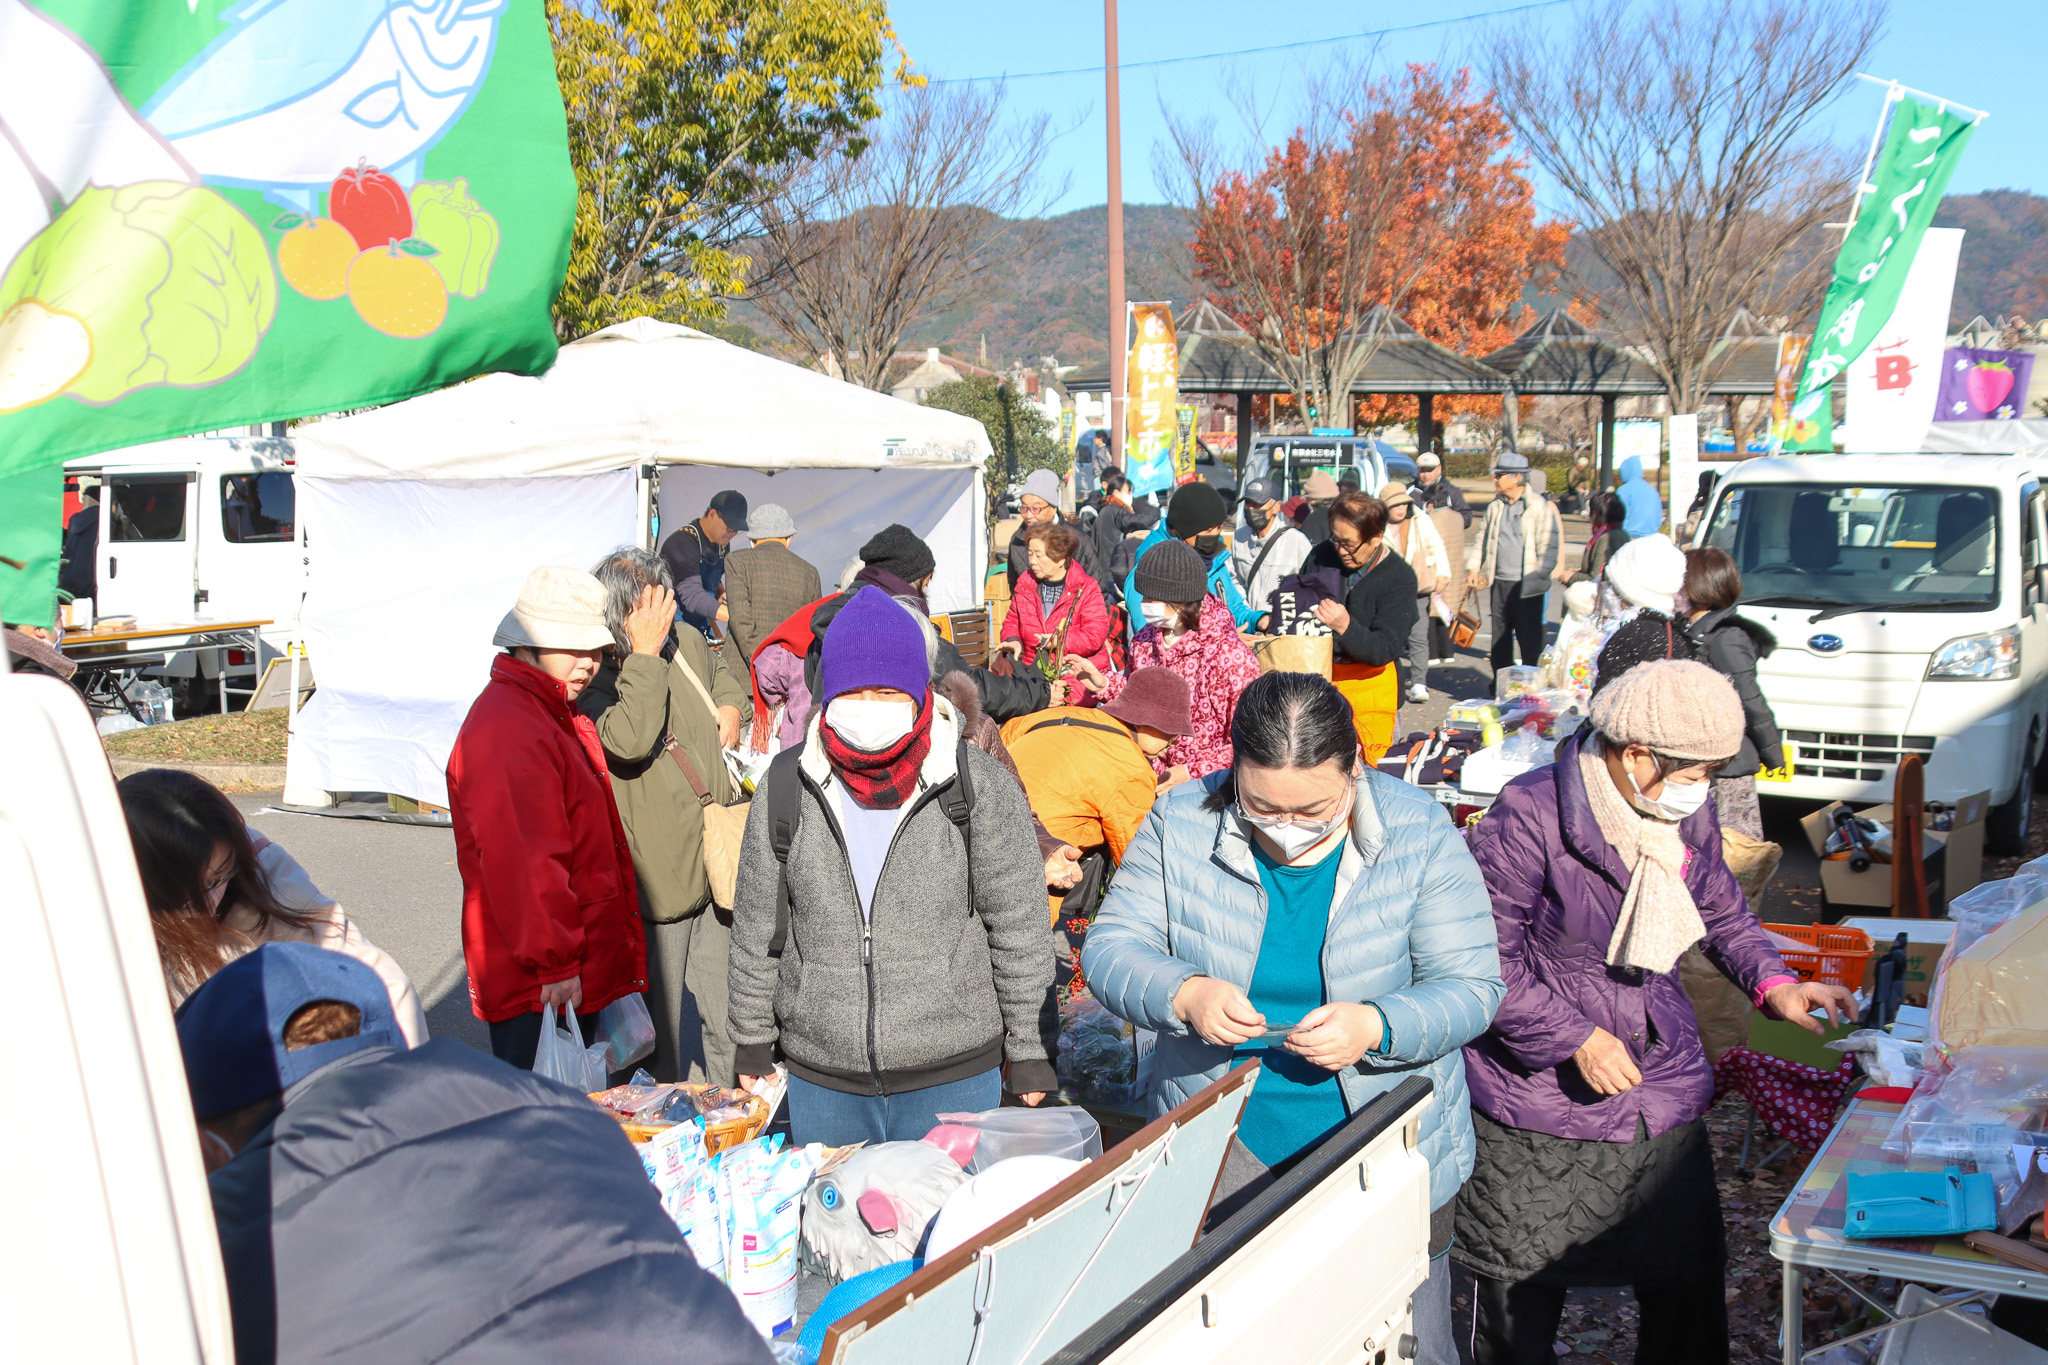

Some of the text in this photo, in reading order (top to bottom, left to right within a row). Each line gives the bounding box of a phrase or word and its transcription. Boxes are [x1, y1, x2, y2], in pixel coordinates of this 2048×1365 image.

[1138, 342, 1167, 458] 軽トラ市
[1163, 343, 1178, 389] つくみ
